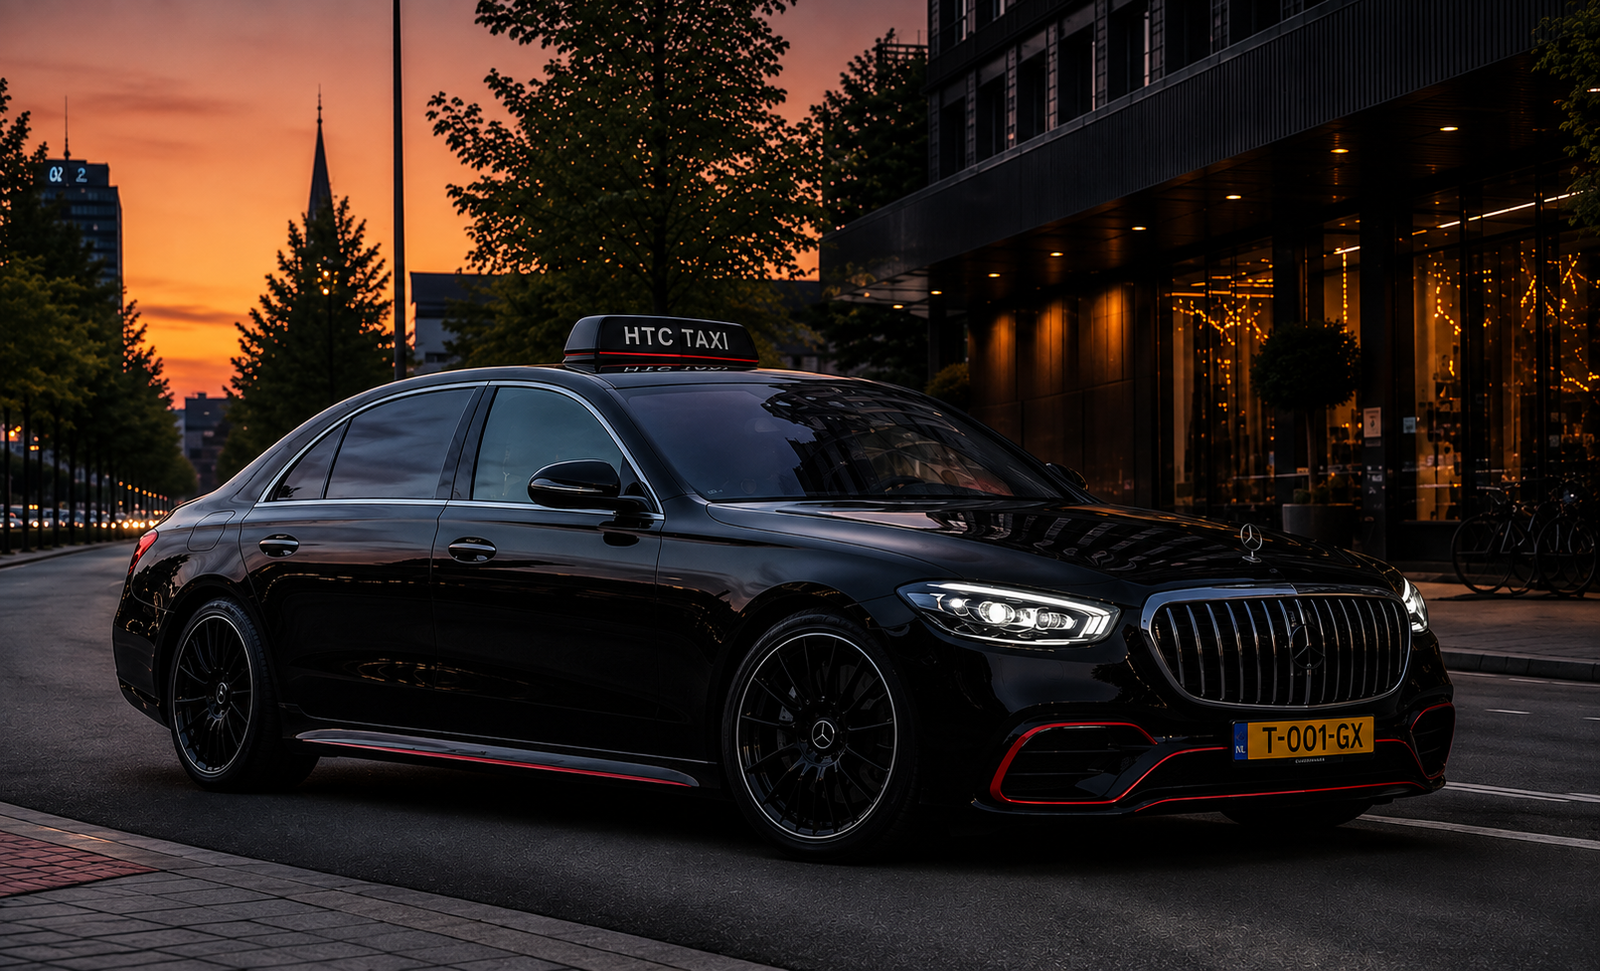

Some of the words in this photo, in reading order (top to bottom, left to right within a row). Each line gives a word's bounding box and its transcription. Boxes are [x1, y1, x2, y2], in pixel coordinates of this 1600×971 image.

[624, 326, 674, 346] HTC
[681, 328, 729, 350] TAXI
[1235, 745, 1246, 754] NL
[1262, 722, 1363, 754] T-001-GX
